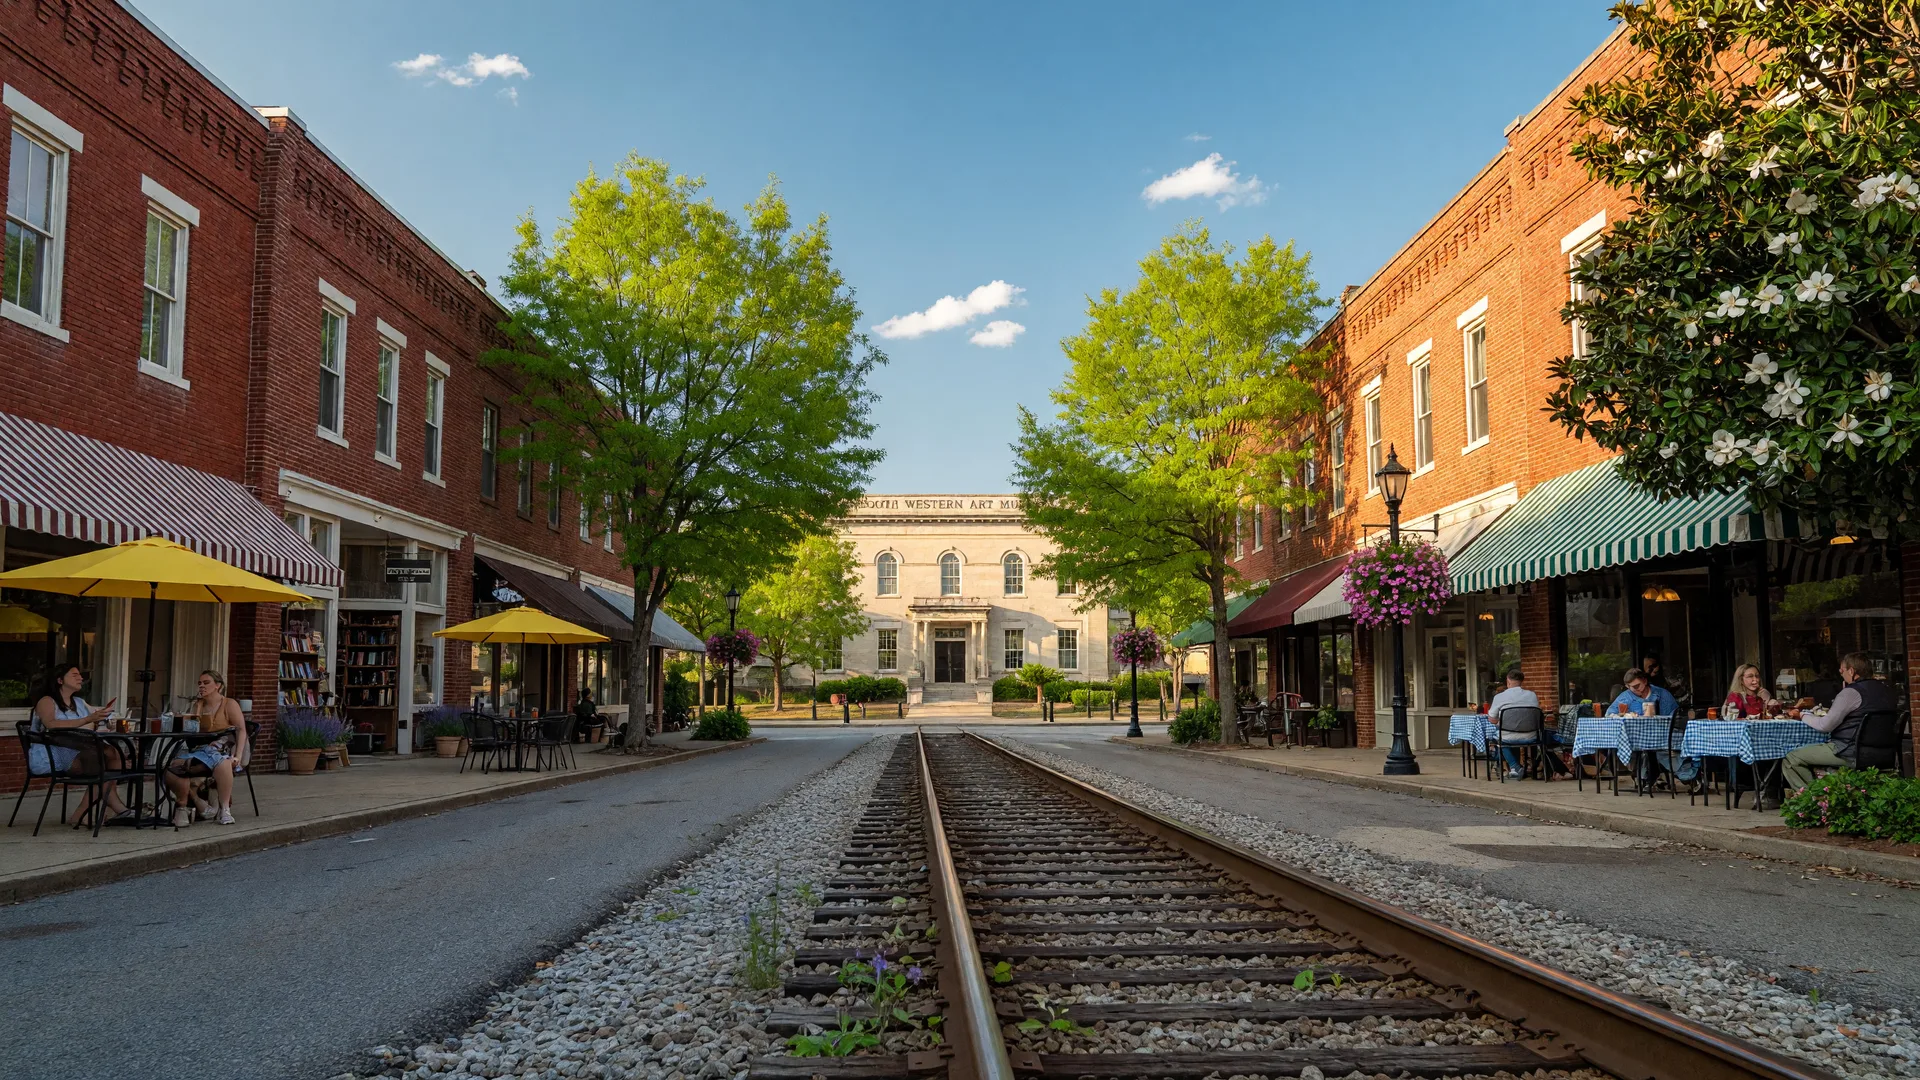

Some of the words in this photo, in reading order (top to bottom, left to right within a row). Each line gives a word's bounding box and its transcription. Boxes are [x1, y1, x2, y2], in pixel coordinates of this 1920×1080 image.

[905, 499, 963, 509] WESTERN
[970, 499, 993, 509] ART
[1000, 499, 1021, 509] MU
